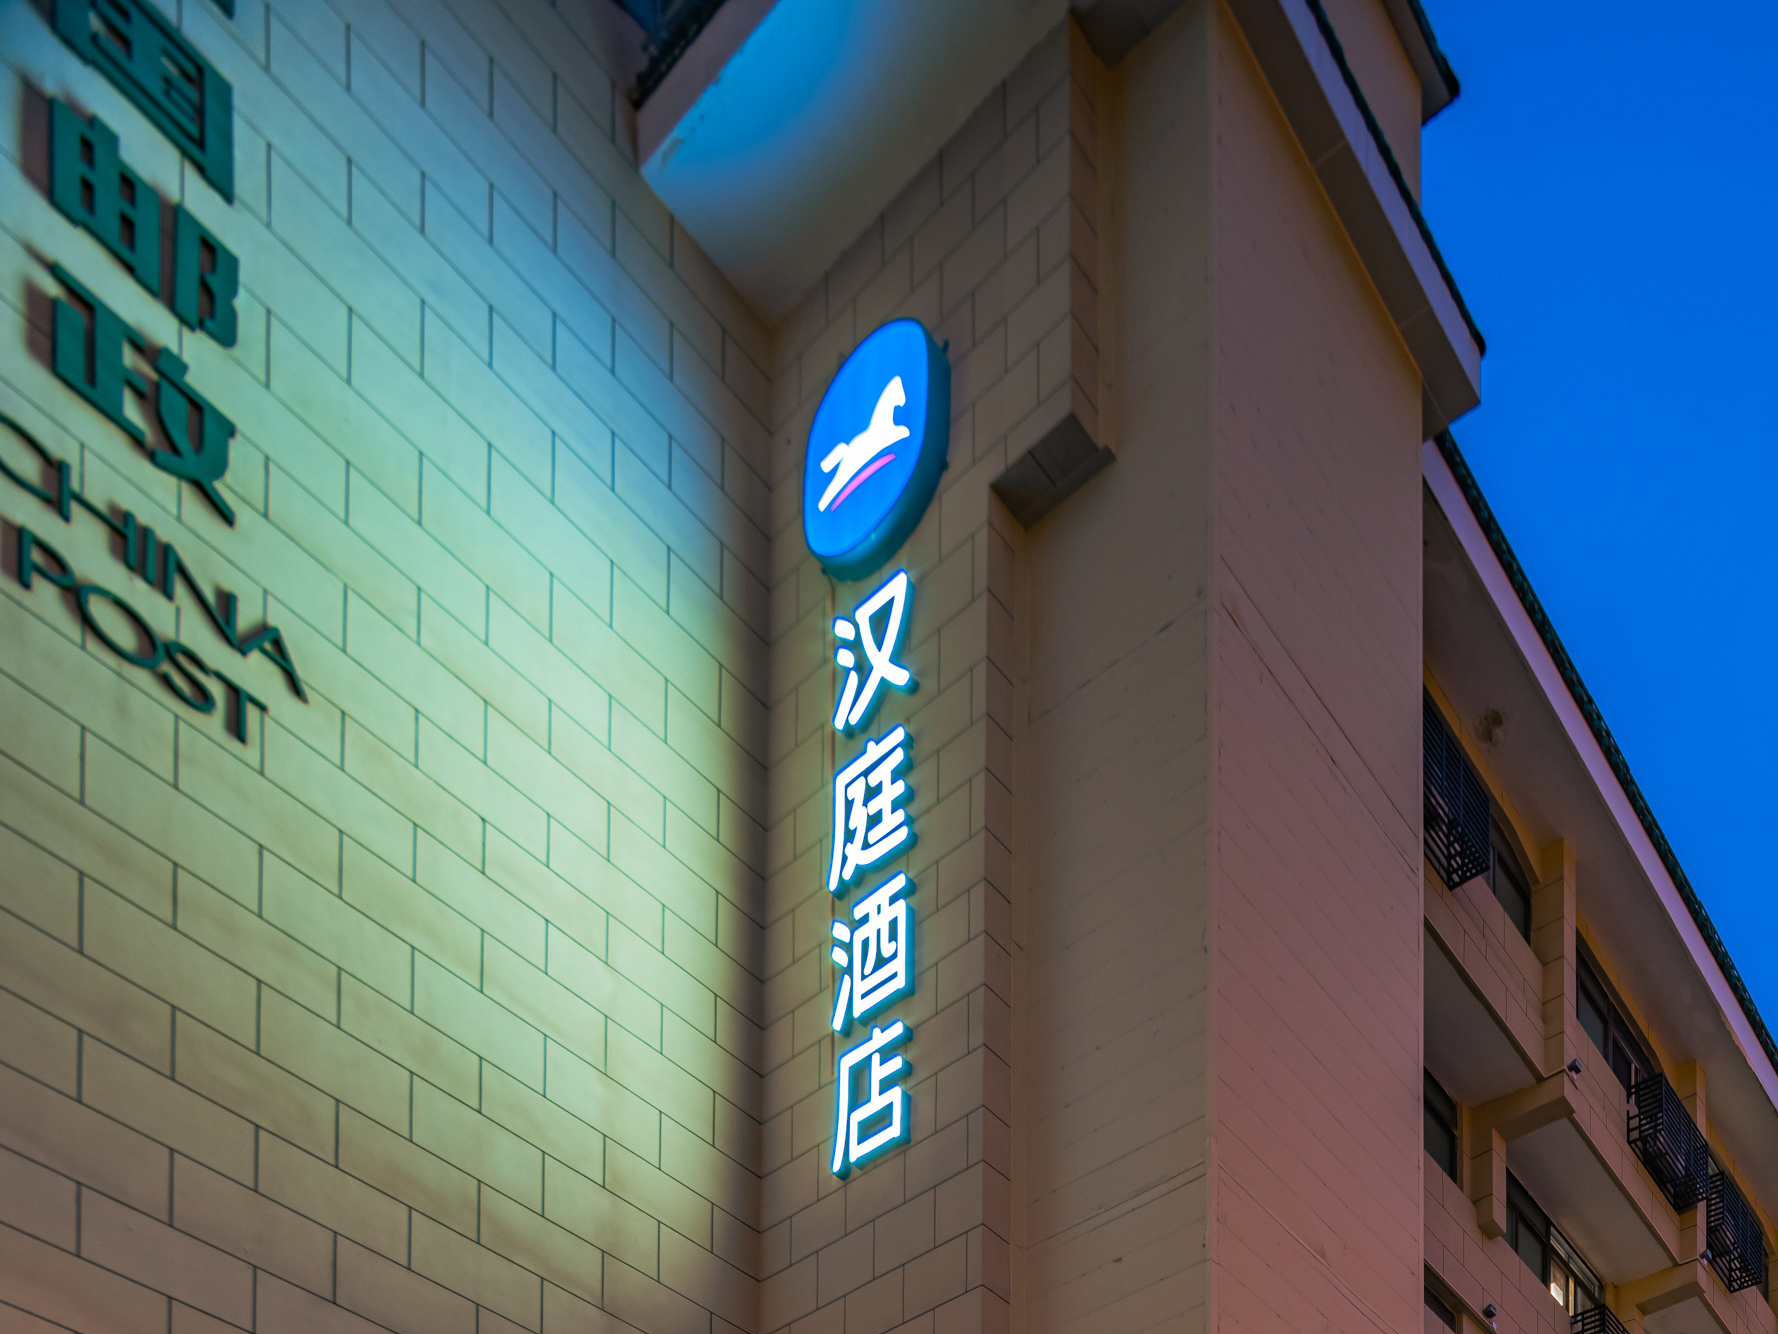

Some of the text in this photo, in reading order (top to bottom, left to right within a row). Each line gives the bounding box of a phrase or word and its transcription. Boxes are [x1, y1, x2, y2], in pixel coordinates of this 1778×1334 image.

[54, 0, 240, 527] 国邮政
[0, 412, 309, 704] CHINA
[18, 525, 269, 745] POST
[828, 569, 915, 1178] 汉庭酒店
